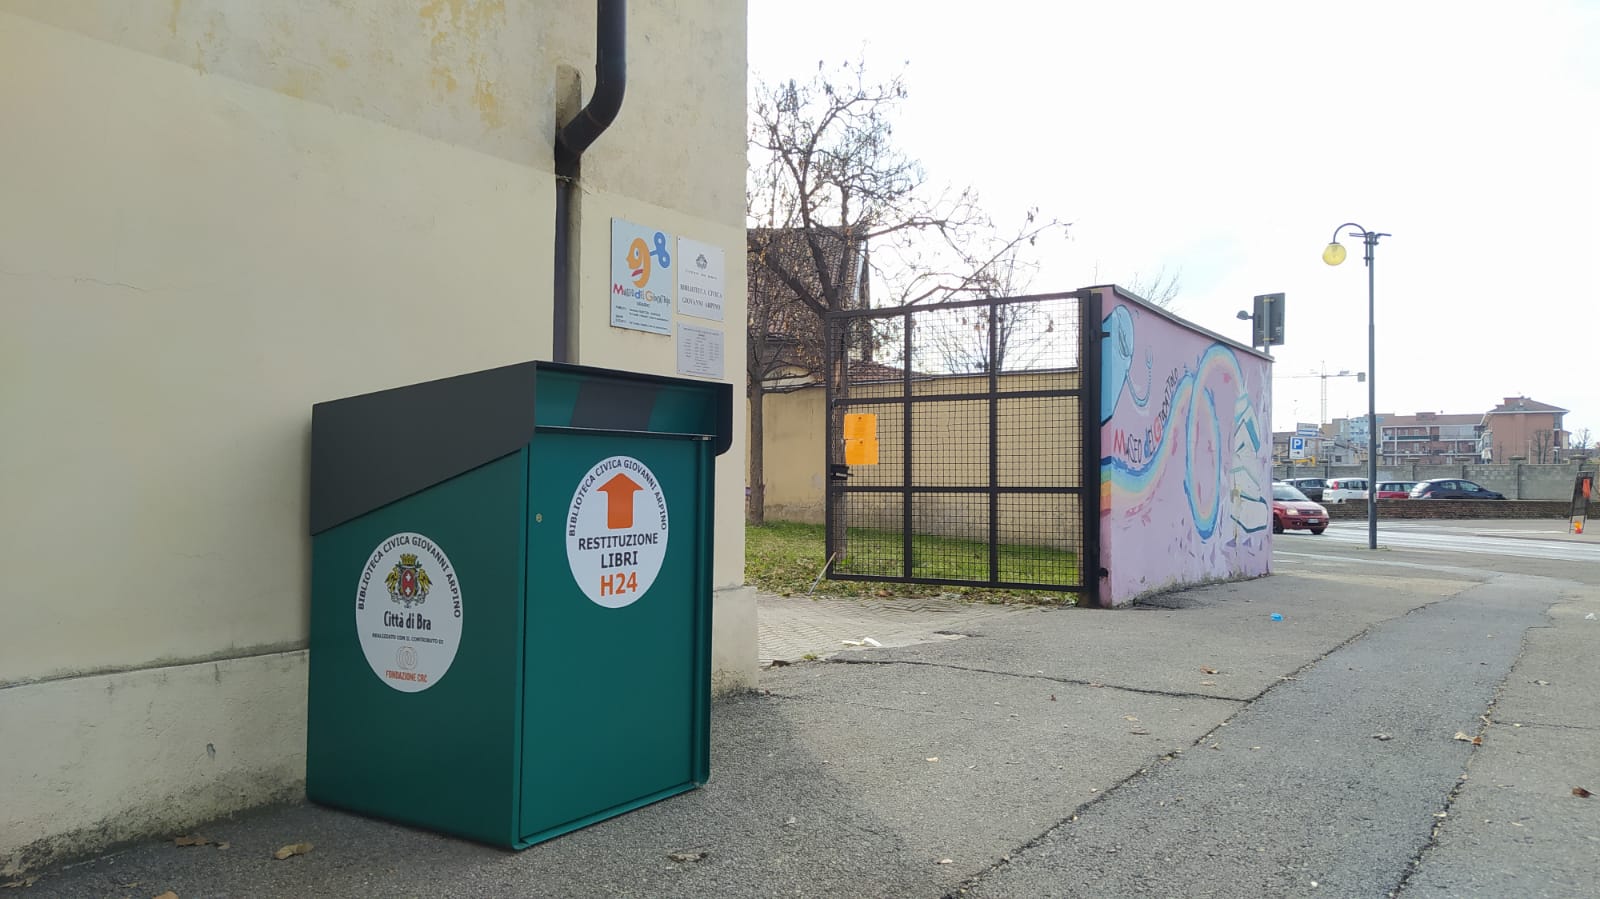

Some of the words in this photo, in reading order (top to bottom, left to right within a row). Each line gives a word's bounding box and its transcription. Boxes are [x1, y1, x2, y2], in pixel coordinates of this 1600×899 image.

[1293, 439, 1302, 449] P
[569, 475, 596, 536] BIBLIOTECA
[595, 459, 622, 477] CIVICA
[623, 459, 657, 490] GIOVANNI
[654, 491, 667, 530] ARPINO
[578, 532, 659, 550] RESTITUZIONE
[601, 551, 638, 569] LIBRI
[358, 551, 384, 610] BIBLIOTECA
[383, 535, 410, 553] CIVICA
[411, 536, 449, 572] GIOVANNI
[446, 573, 461, 618] ARPINO
[600, 572, 638, 597] H24
[384, 610, 404, 629] Città
[405, 613, 415, 630] di
[416, 614, 432, 631] Bra
[385, 669, 417, 682] FONDAZIONE
[417, 672, 428, 684] CRC
